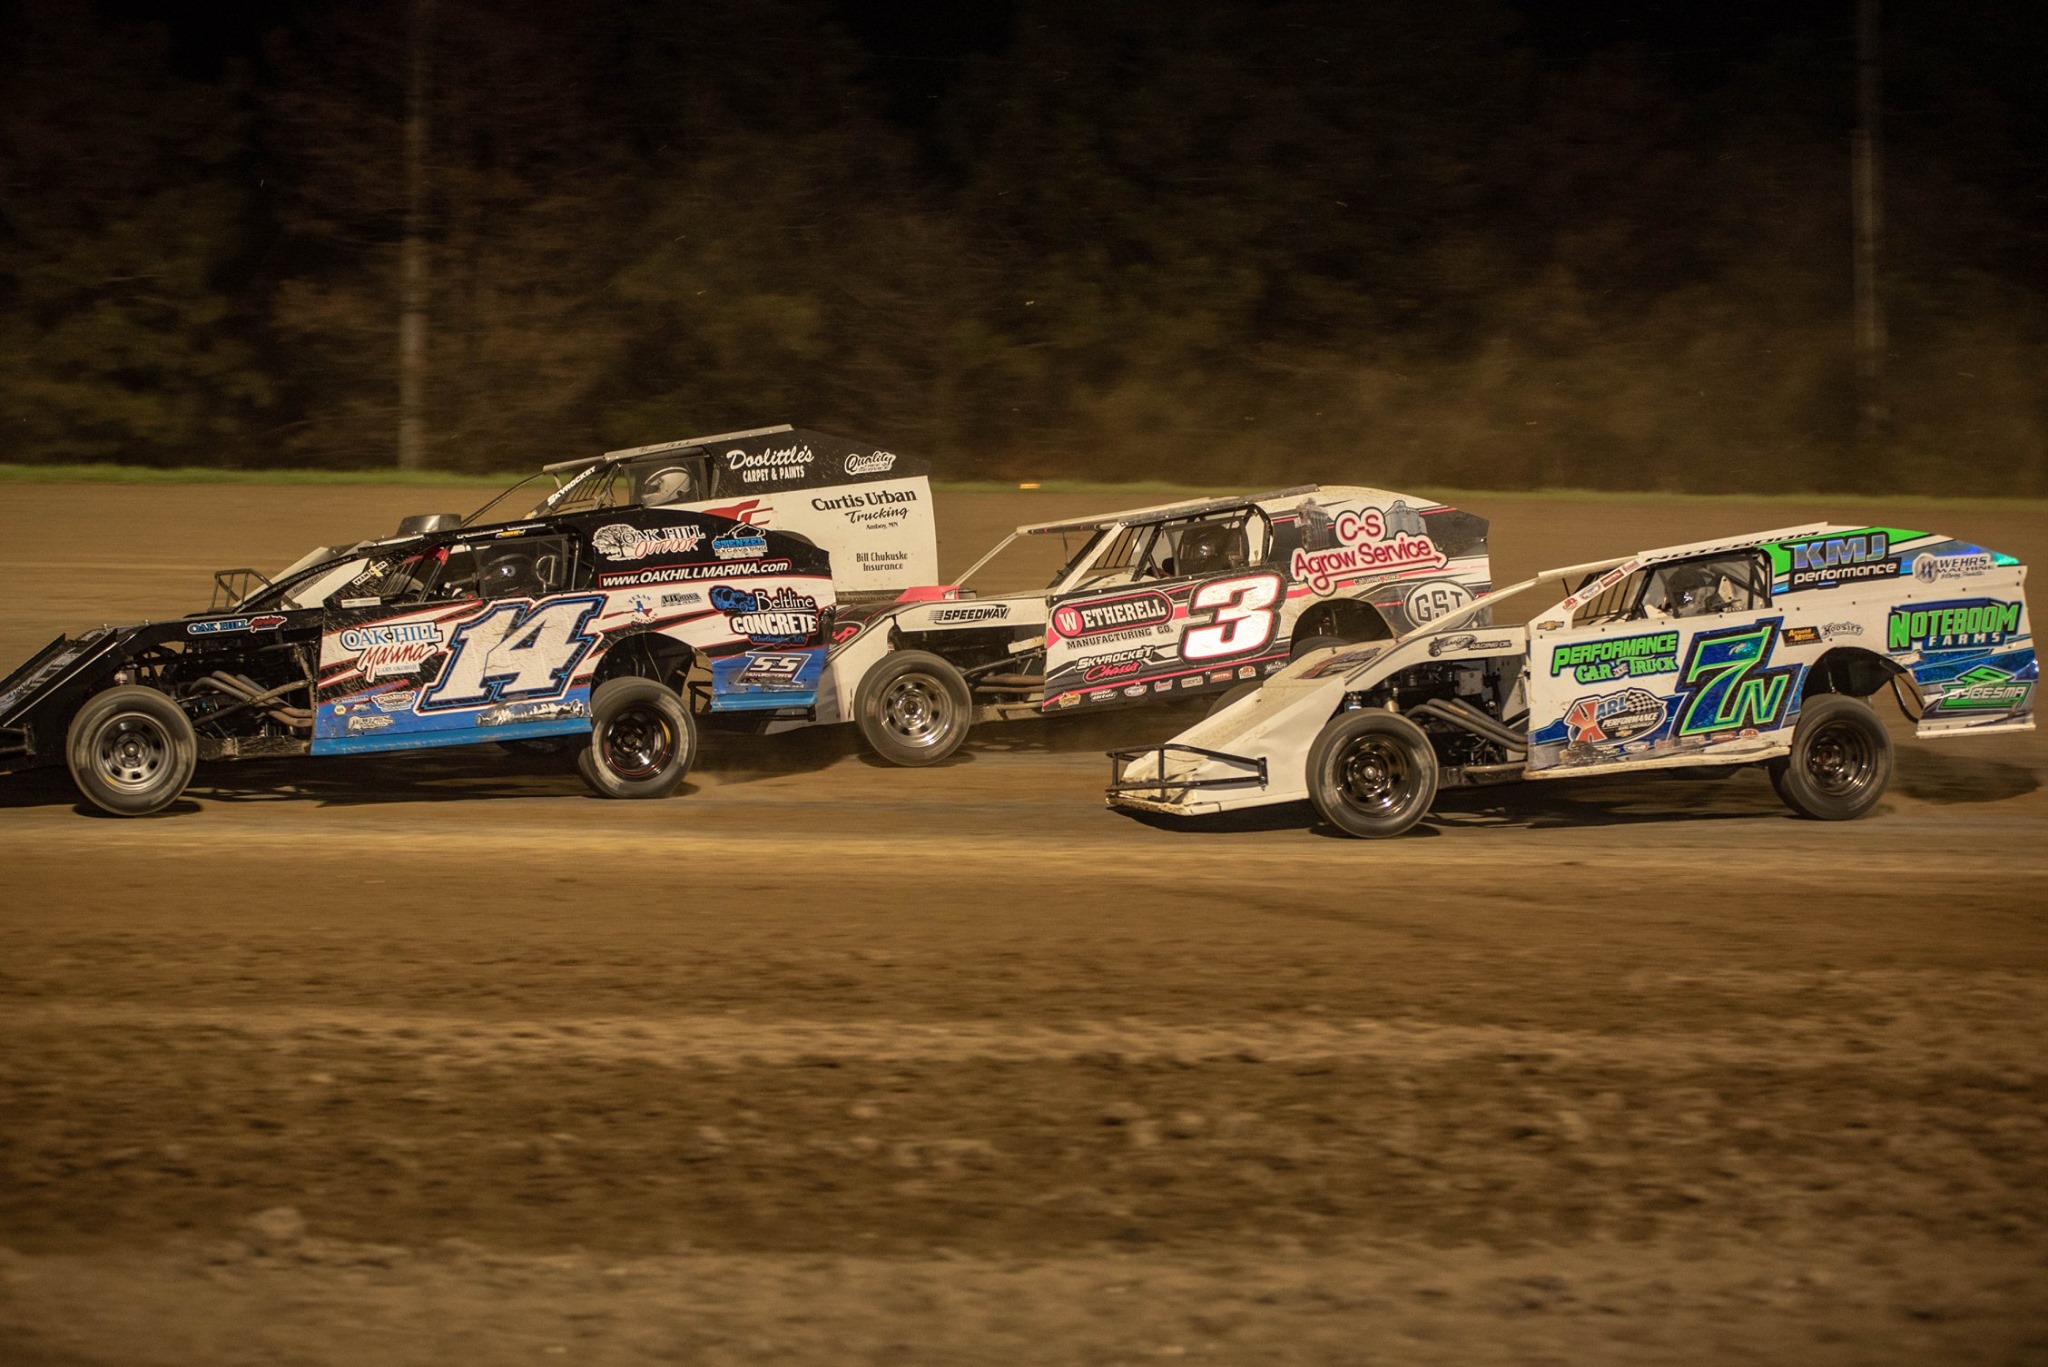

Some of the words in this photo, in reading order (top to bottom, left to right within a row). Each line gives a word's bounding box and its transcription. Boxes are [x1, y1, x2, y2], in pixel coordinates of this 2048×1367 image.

[726, 445, 815, 470] Doolittle's
[846, 452, 893, 472] Quality
[743, 468, 769, 483] CARPET
[771, 468, 777, 480] &
[779, 465, 805, 480] PAINTS
[547, 465, 596, 507] SKYROCKET
[811, 494, 865, 511] Curtis
[864, 489, 917, 506] Urban
[845, 506, 909, 524] Trucking
[622, 529, 662, 545] OAK
[663, 525, 707, 541] HILL
[1340, 513, 1381, 542] C-S
[635, 537, 699, 559] OUTDOOR
[712, 537, 764, 550] STENZEL
[1787, 534, 1886, 570] KMJ
[856, 552, 869, 563] Bill
[870, 550, 908, 562] Chukuske
[863, 561, 903, 572] Insurance
[1294, 549, 1356, 591] Agrow
[1357, 537, 1432, 565] Service
[1940, 556, 1988, 568] WEHRS
[602, 562, 789, 587] www.OAKHILLMARINA.com
[1793, 562, 1897, 585] performance
[755, 590, 815, 612] Beltline
[732, 613, 818, 635] CONCRETE
[943, 608, 1008, 620] SPEEDWAY
[1058, 599, 1167, 632] WETHERELL
[1184, 574, 1280, 659] 3
[189, 622, 220, 634] OAK
[219, 619, 249, 631] HILL
[343, 628, 388, 648] OAK
[393, 623, 438, 642] HILL
[1066, 628, 1152, 650] MANUFACTURING
[1157, 624, 1174, 635] CO.
[1890, 603, 2020, 650] NOTEBOOM
[1928, 631, 2001, 647] FARMS
[361, 641, 428, 682] Marina
[422, 594, 606, 710] 14
[1078, 645, 1154, 670] SKYROCKET
[1551, 632, 1678, 676] PERFORMANCE
[1085, 659, 1141, 682] Chassis
[1576, 663, 1612, 683] CAR
[1620, 655, 1678, 676] TRUCK
[1601, 712, 1659, 728] PERFORMANCE
